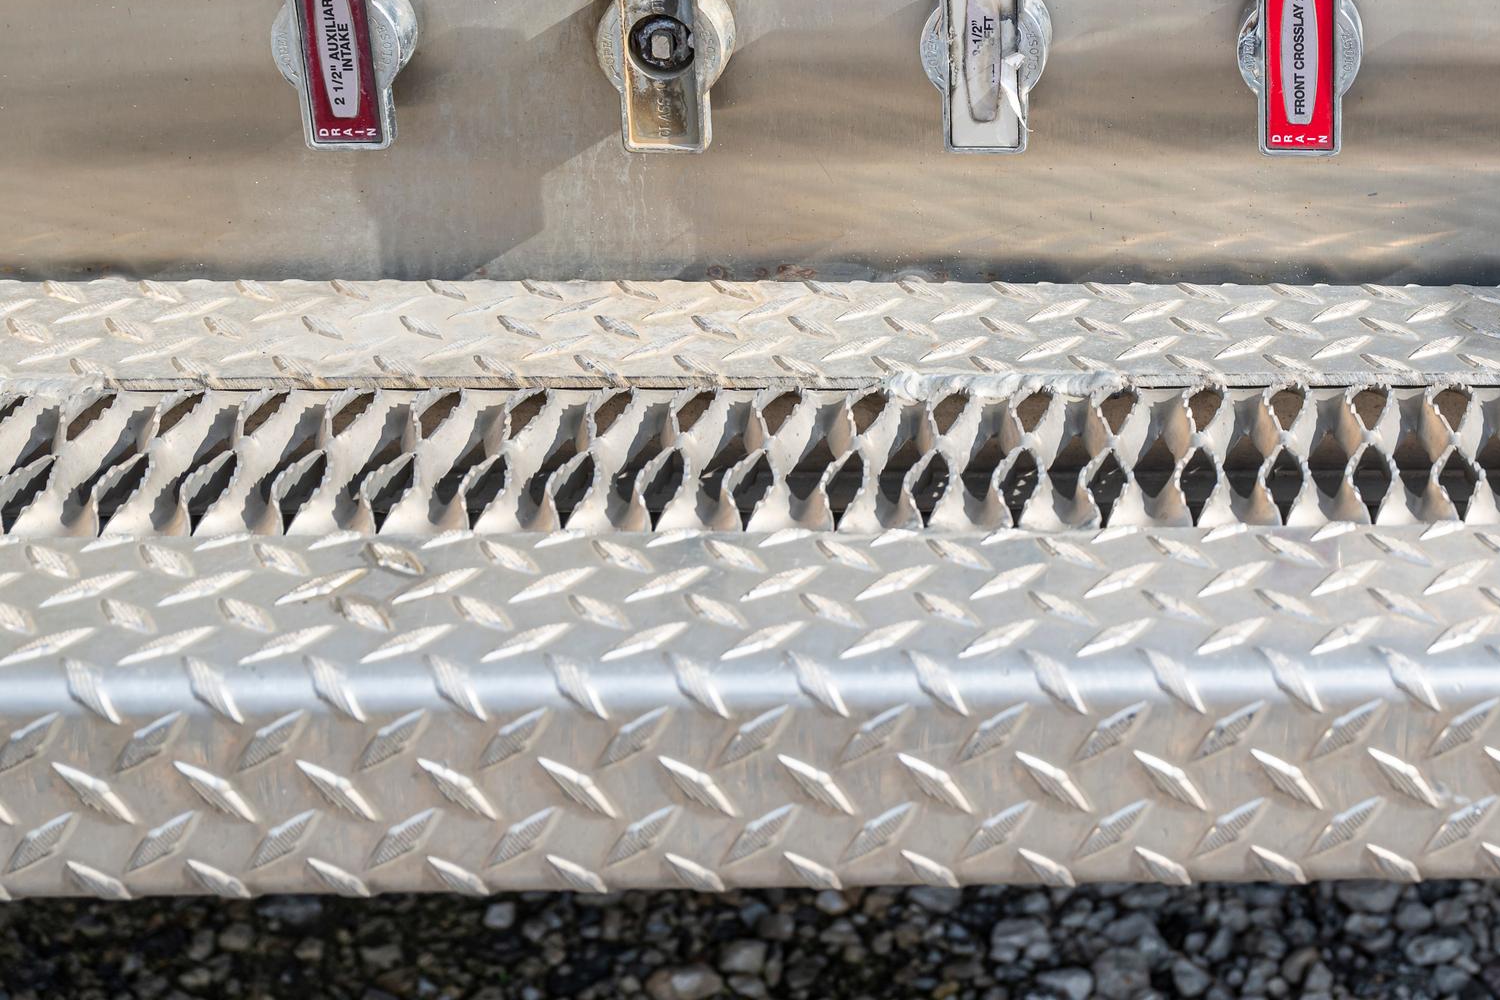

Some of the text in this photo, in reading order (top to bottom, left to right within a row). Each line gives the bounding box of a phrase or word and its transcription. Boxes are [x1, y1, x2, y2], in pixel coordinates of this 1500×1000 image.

[337, 23, 353, 72] INTAKE
[377, 24, 392, 67] CLOSE
[1026, 33, 1039, 70] CLOSE
[1293, 3, 1305, 69] CROSSLAY
[330, 66, 344, 93] 1/2"
[1294, 78, 1306, 115] FRONT
[334, 97, 345, 105] 2
[319, 128, 377, 137] DRAIN
[1271, 134, 1328, 143] DRAIN
